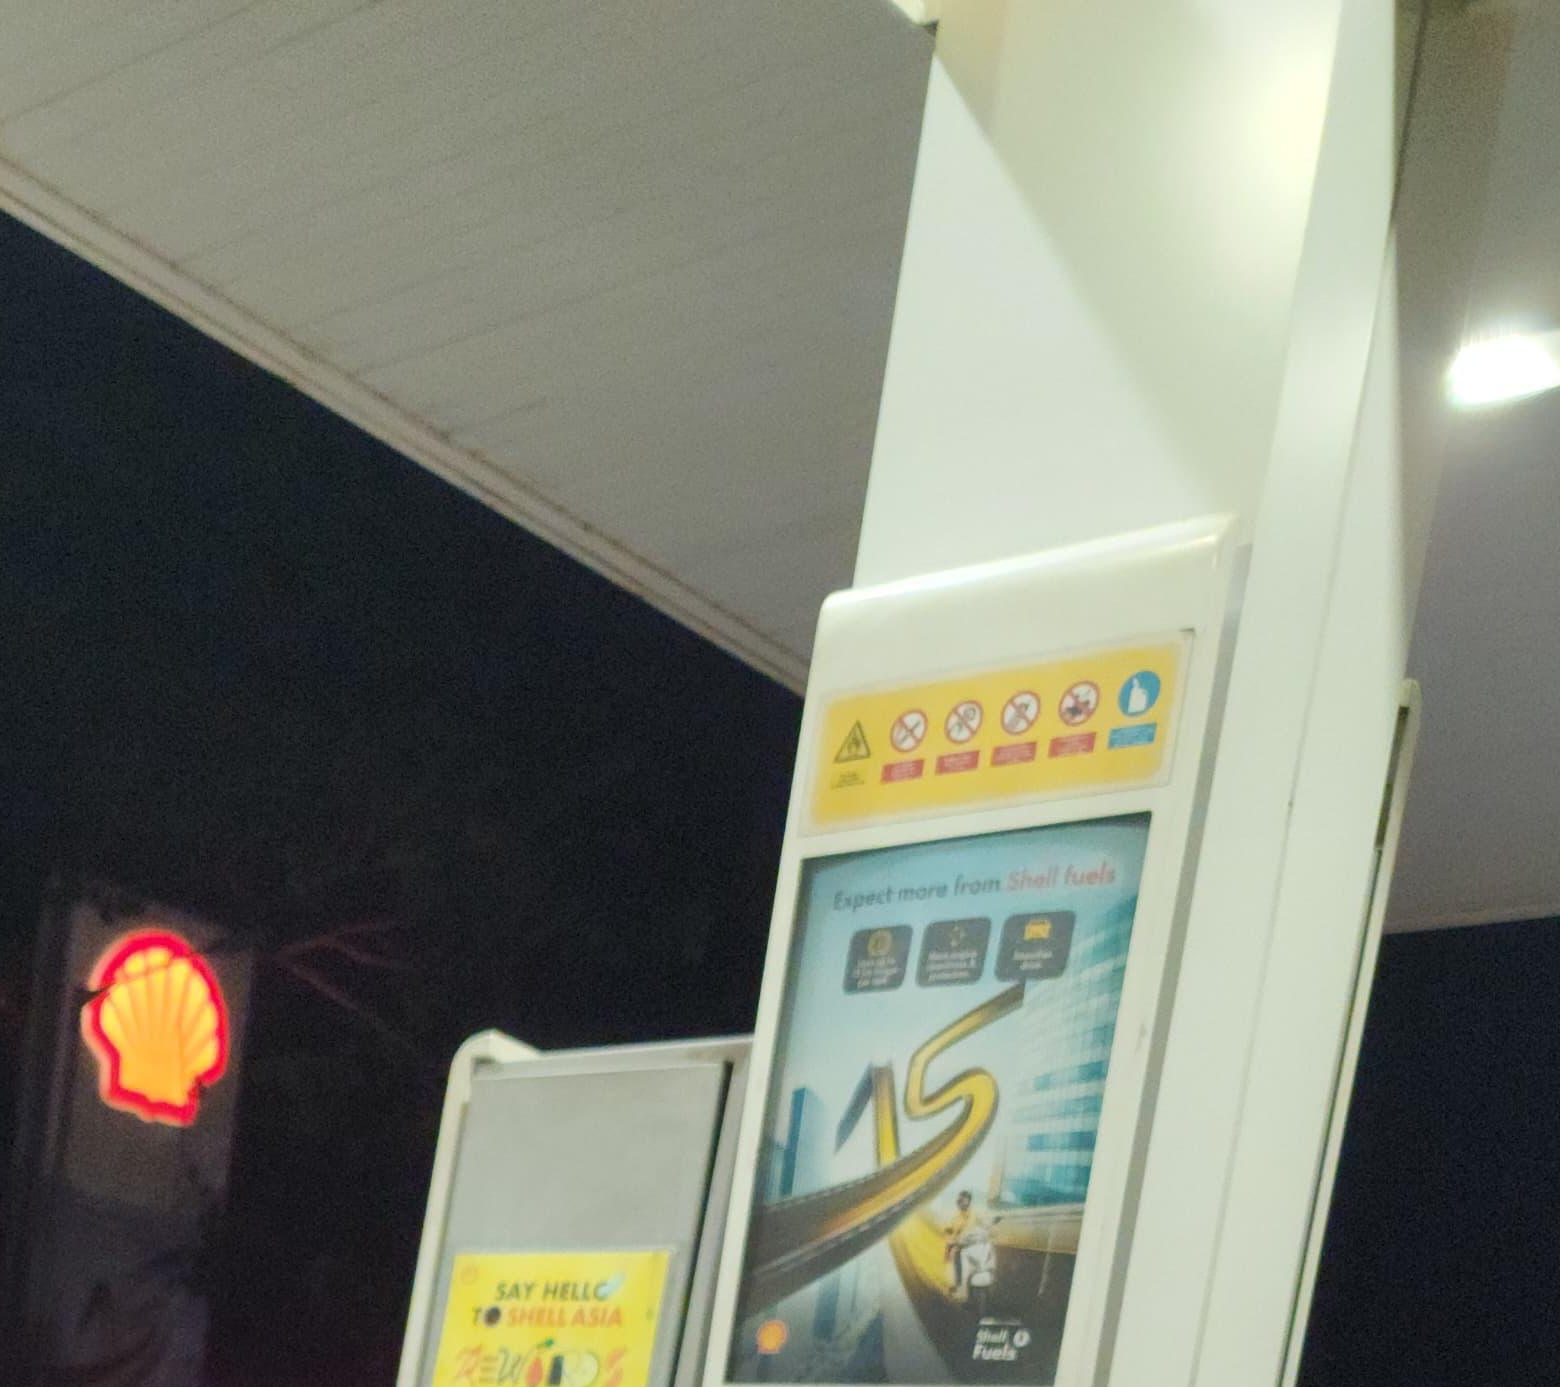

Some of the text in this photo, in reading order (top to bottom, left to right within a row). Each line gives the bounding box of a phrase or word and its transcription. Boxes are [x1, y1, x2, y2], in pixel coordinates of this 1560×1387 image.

[832, 861, 1117, 912] Expect more from Shell fuels
[496, 1281, 536, 1302] SAY
[506, 1306, 567, 1328] SHELL
[570, 1306, 624, 1327] ASIA
[972, 1343, 1018, 1361] Fuels
